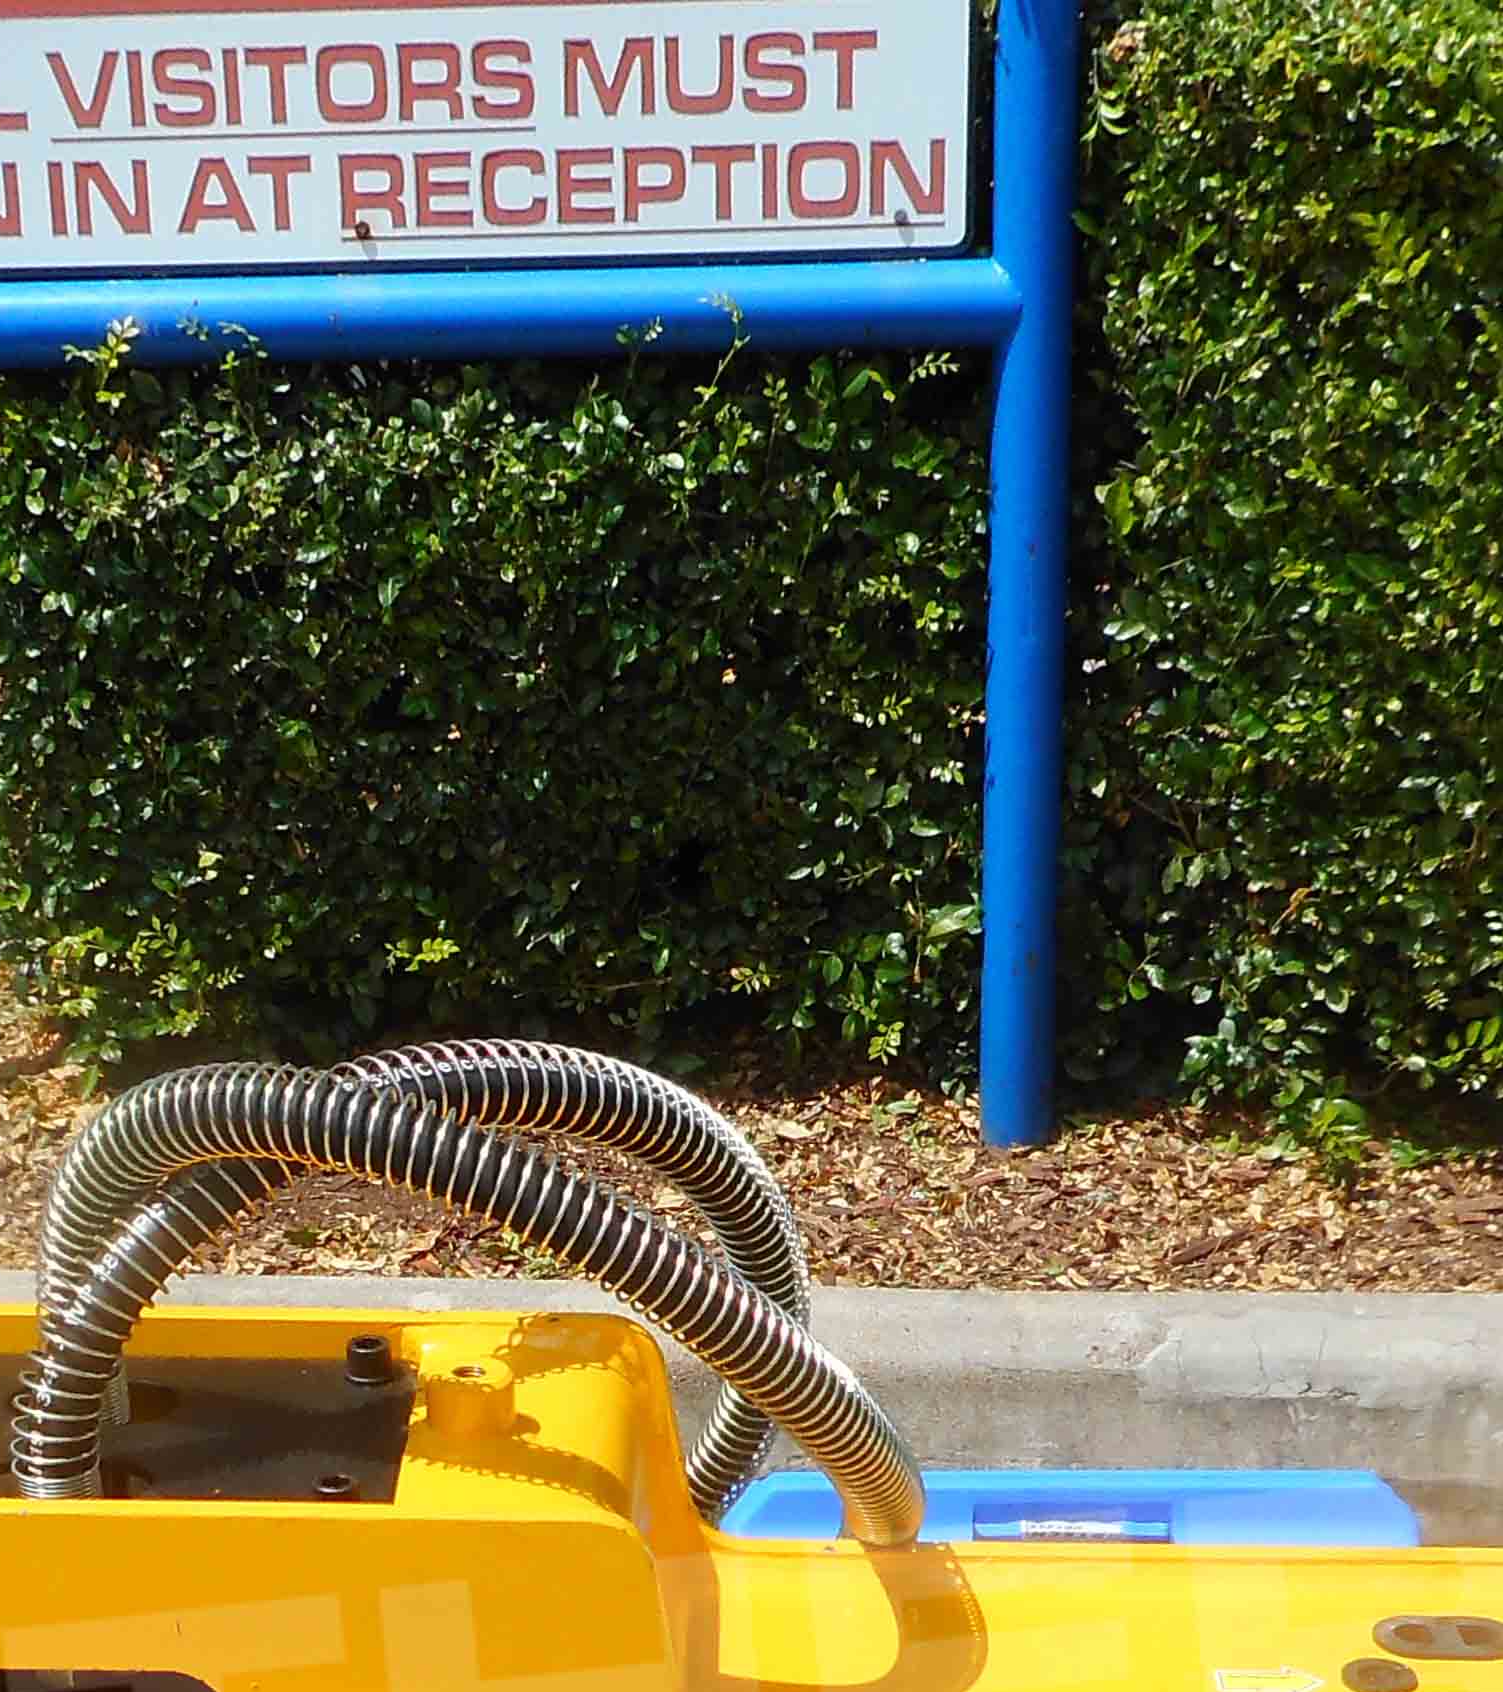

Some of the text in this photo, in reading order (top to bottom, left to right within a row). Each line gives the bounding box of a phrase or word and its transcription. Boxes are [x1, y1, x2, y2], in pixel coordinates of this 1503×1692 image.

[48, 39, 535, 130] VISITORS
[564, 30, 879, 118] MUST
[48, 158, 150, 235] IN
[178, 154, 313, 233] AT
[339, 137, 947, 230] RECEPTION
